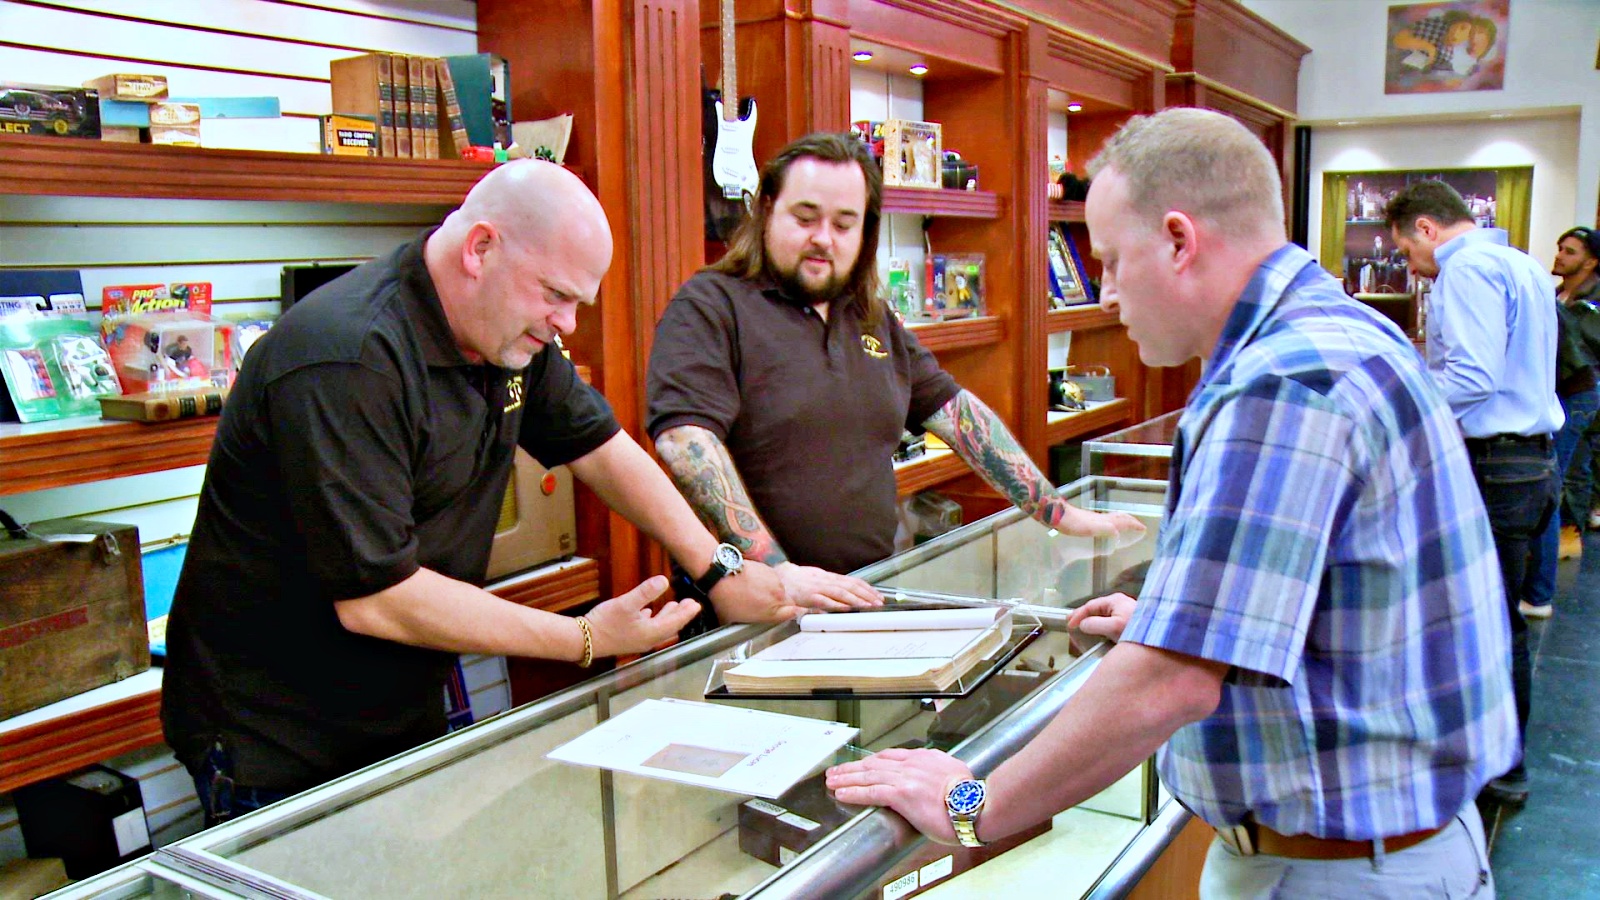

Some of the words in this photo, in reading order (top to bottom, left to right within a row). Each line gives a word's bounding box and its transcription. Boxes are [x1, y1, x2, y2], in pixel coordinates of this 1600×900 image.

[354, 131, 374, 140] CONTROL
[343, 137, 369, 147] RECEIVER
[132, 289, 154, 301] PRO
[0, 301, 21, 310] TING
[889, 873, 916, 893] 490986
